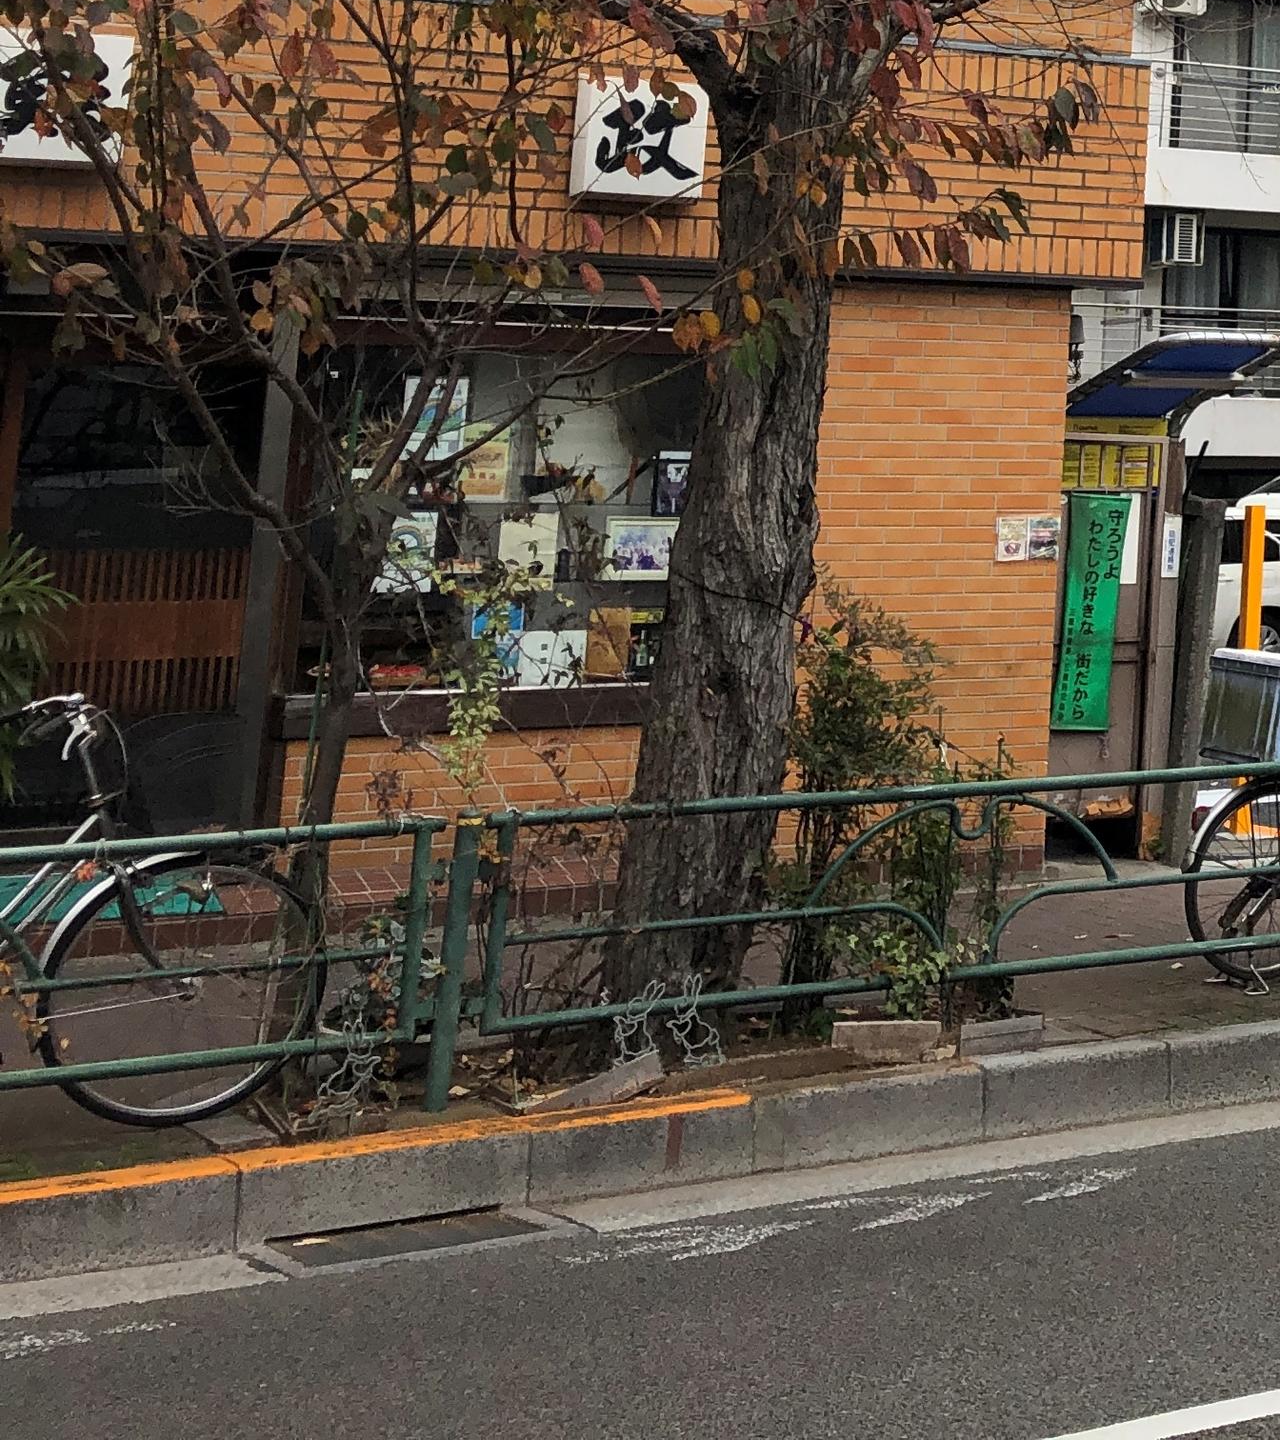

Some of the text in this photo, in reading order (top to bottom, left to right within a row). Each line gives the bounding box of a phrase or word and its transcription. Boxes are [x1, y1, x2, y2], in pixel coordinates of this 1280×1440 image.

[594, 98, 700, 181] 政
[1103, 509, 1125, 580] 守ろうよ
[1072, 520, 1104, 720] わたしの好きな 街だから
